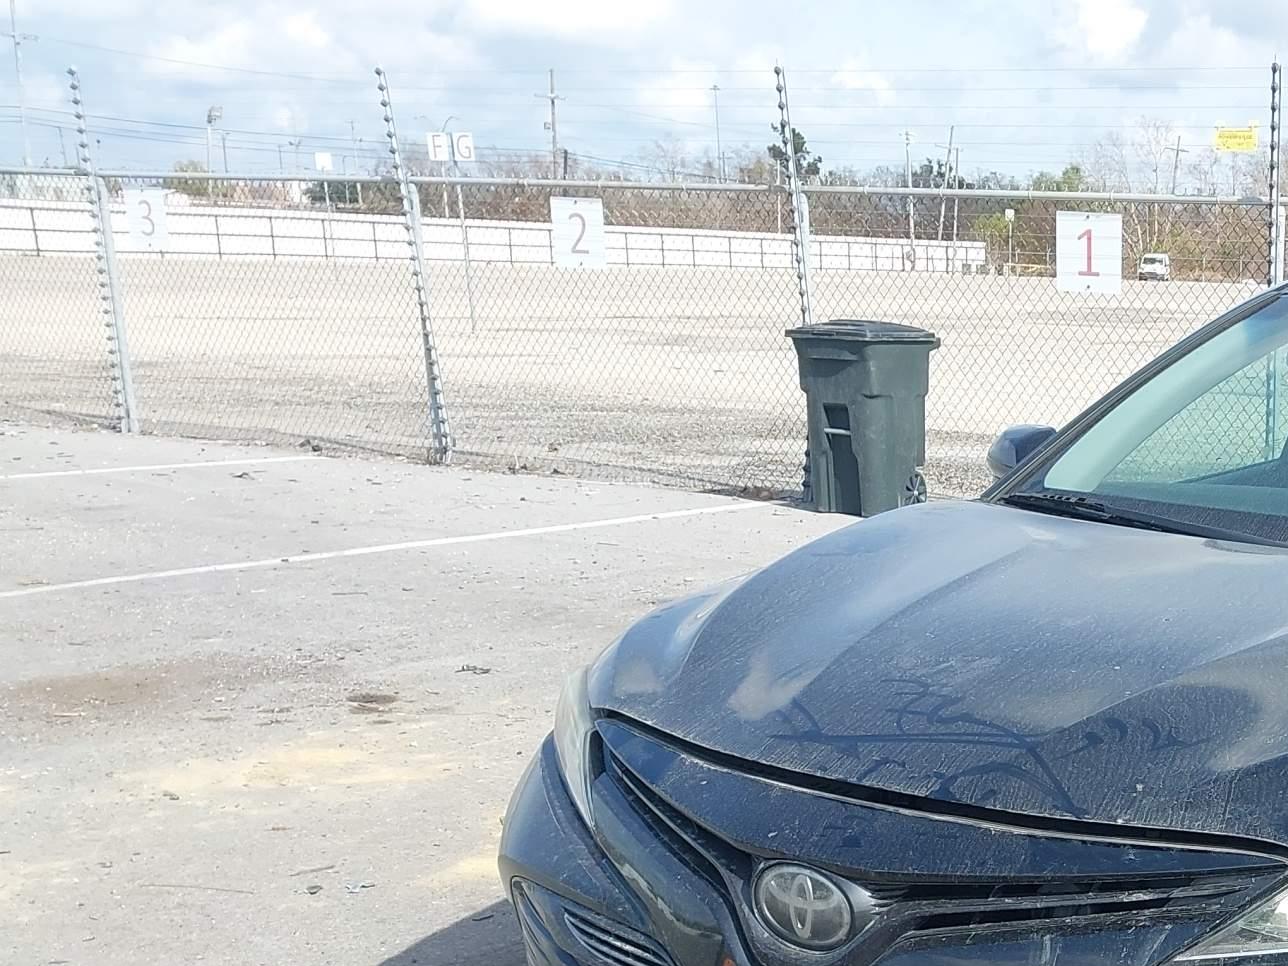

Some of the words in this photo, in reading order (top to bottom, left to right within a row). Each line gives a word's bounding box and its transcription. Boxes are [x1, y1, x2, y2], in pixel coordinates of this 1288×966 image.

[432, 135, 442, 159] F
[456, 134, 471, 159] G
[138, 200, 155, 236] 3
[568, 212, 590, 254] 2
[1077, 229, 1100, 277] 1
